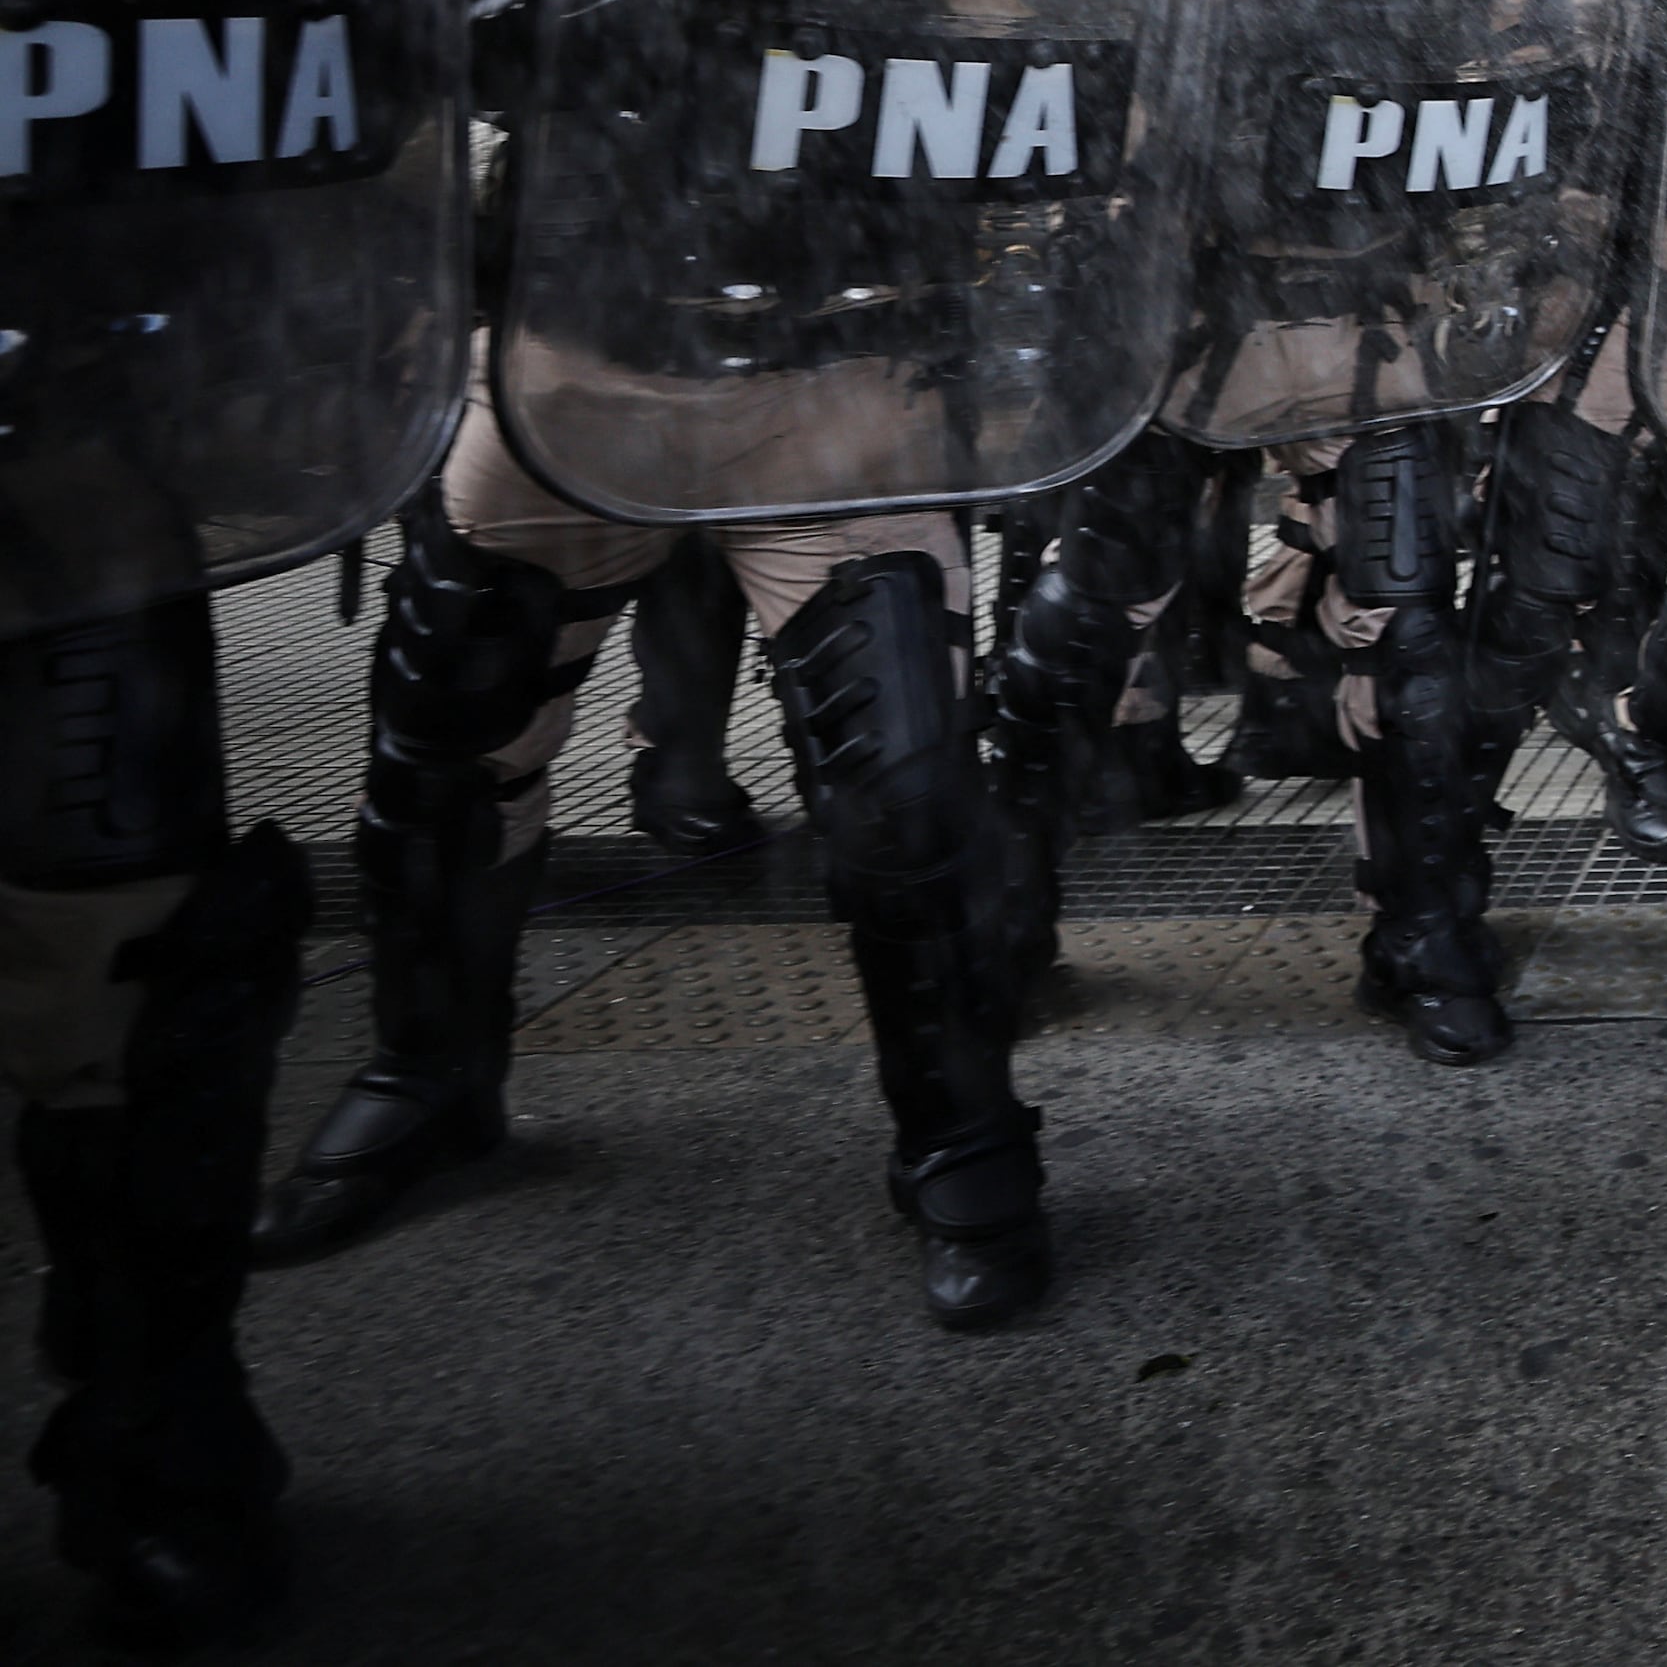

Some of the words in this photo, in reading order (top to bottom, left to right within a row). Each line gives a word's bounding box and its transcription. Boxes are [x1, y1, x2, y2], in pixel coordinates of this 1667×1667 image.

[0, 15, 358, 177] PNA
[749, 48, 1078, 179] PNA
[1317, 94, 1549, 192] PNA
